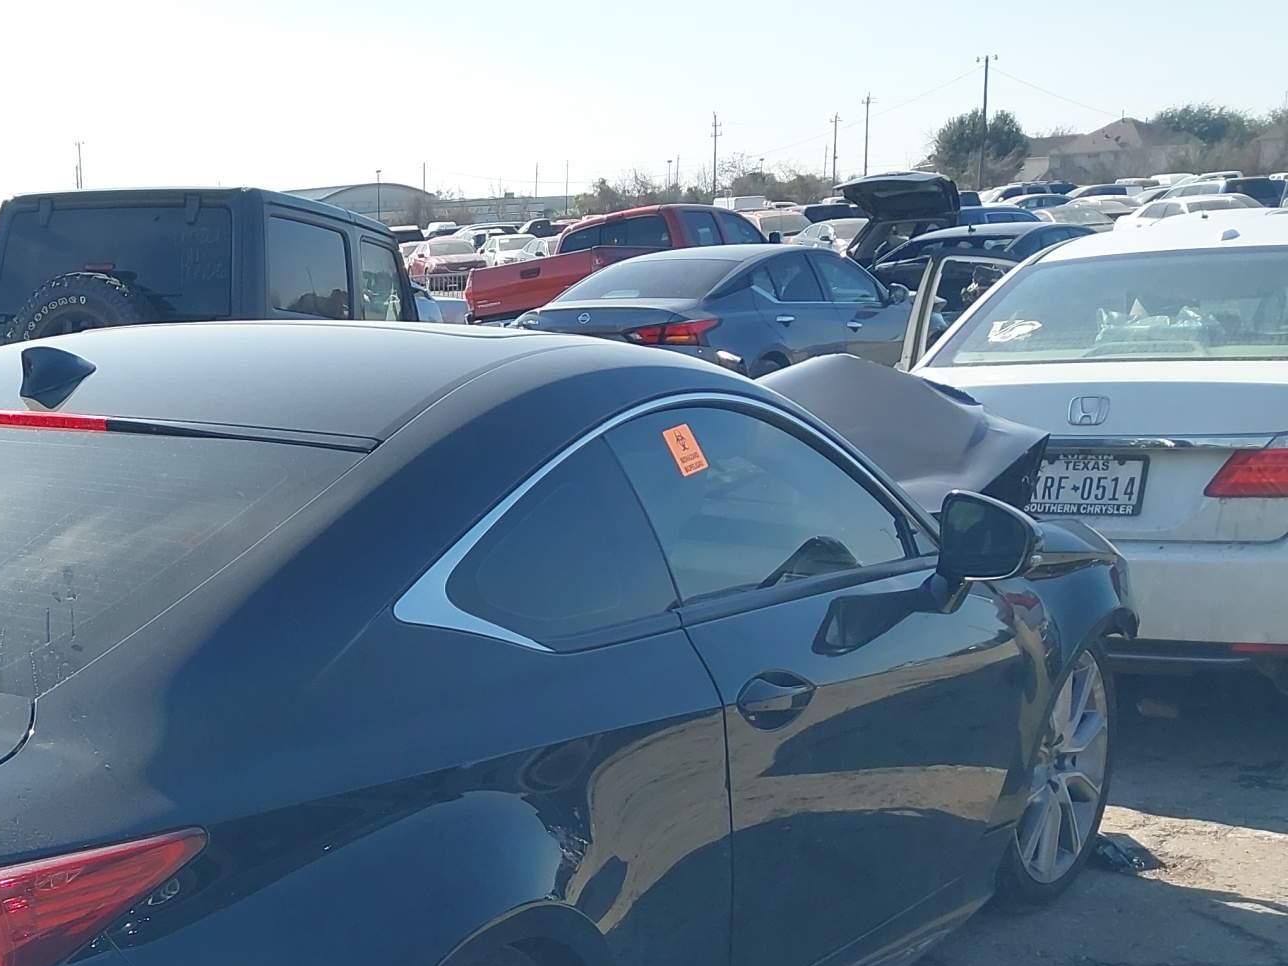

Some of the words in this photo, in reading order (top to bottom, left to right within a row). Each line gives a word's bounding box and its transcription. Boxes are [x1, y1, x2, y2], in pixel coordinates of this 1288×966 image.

[1063, 460, 1110, 471] TEXAS
[1080, 475, 1137, 501] 0514
[1023, 503, 1078, 514] SOUTHERN
[1079, 504, 1134, 515] CHRYSLER
